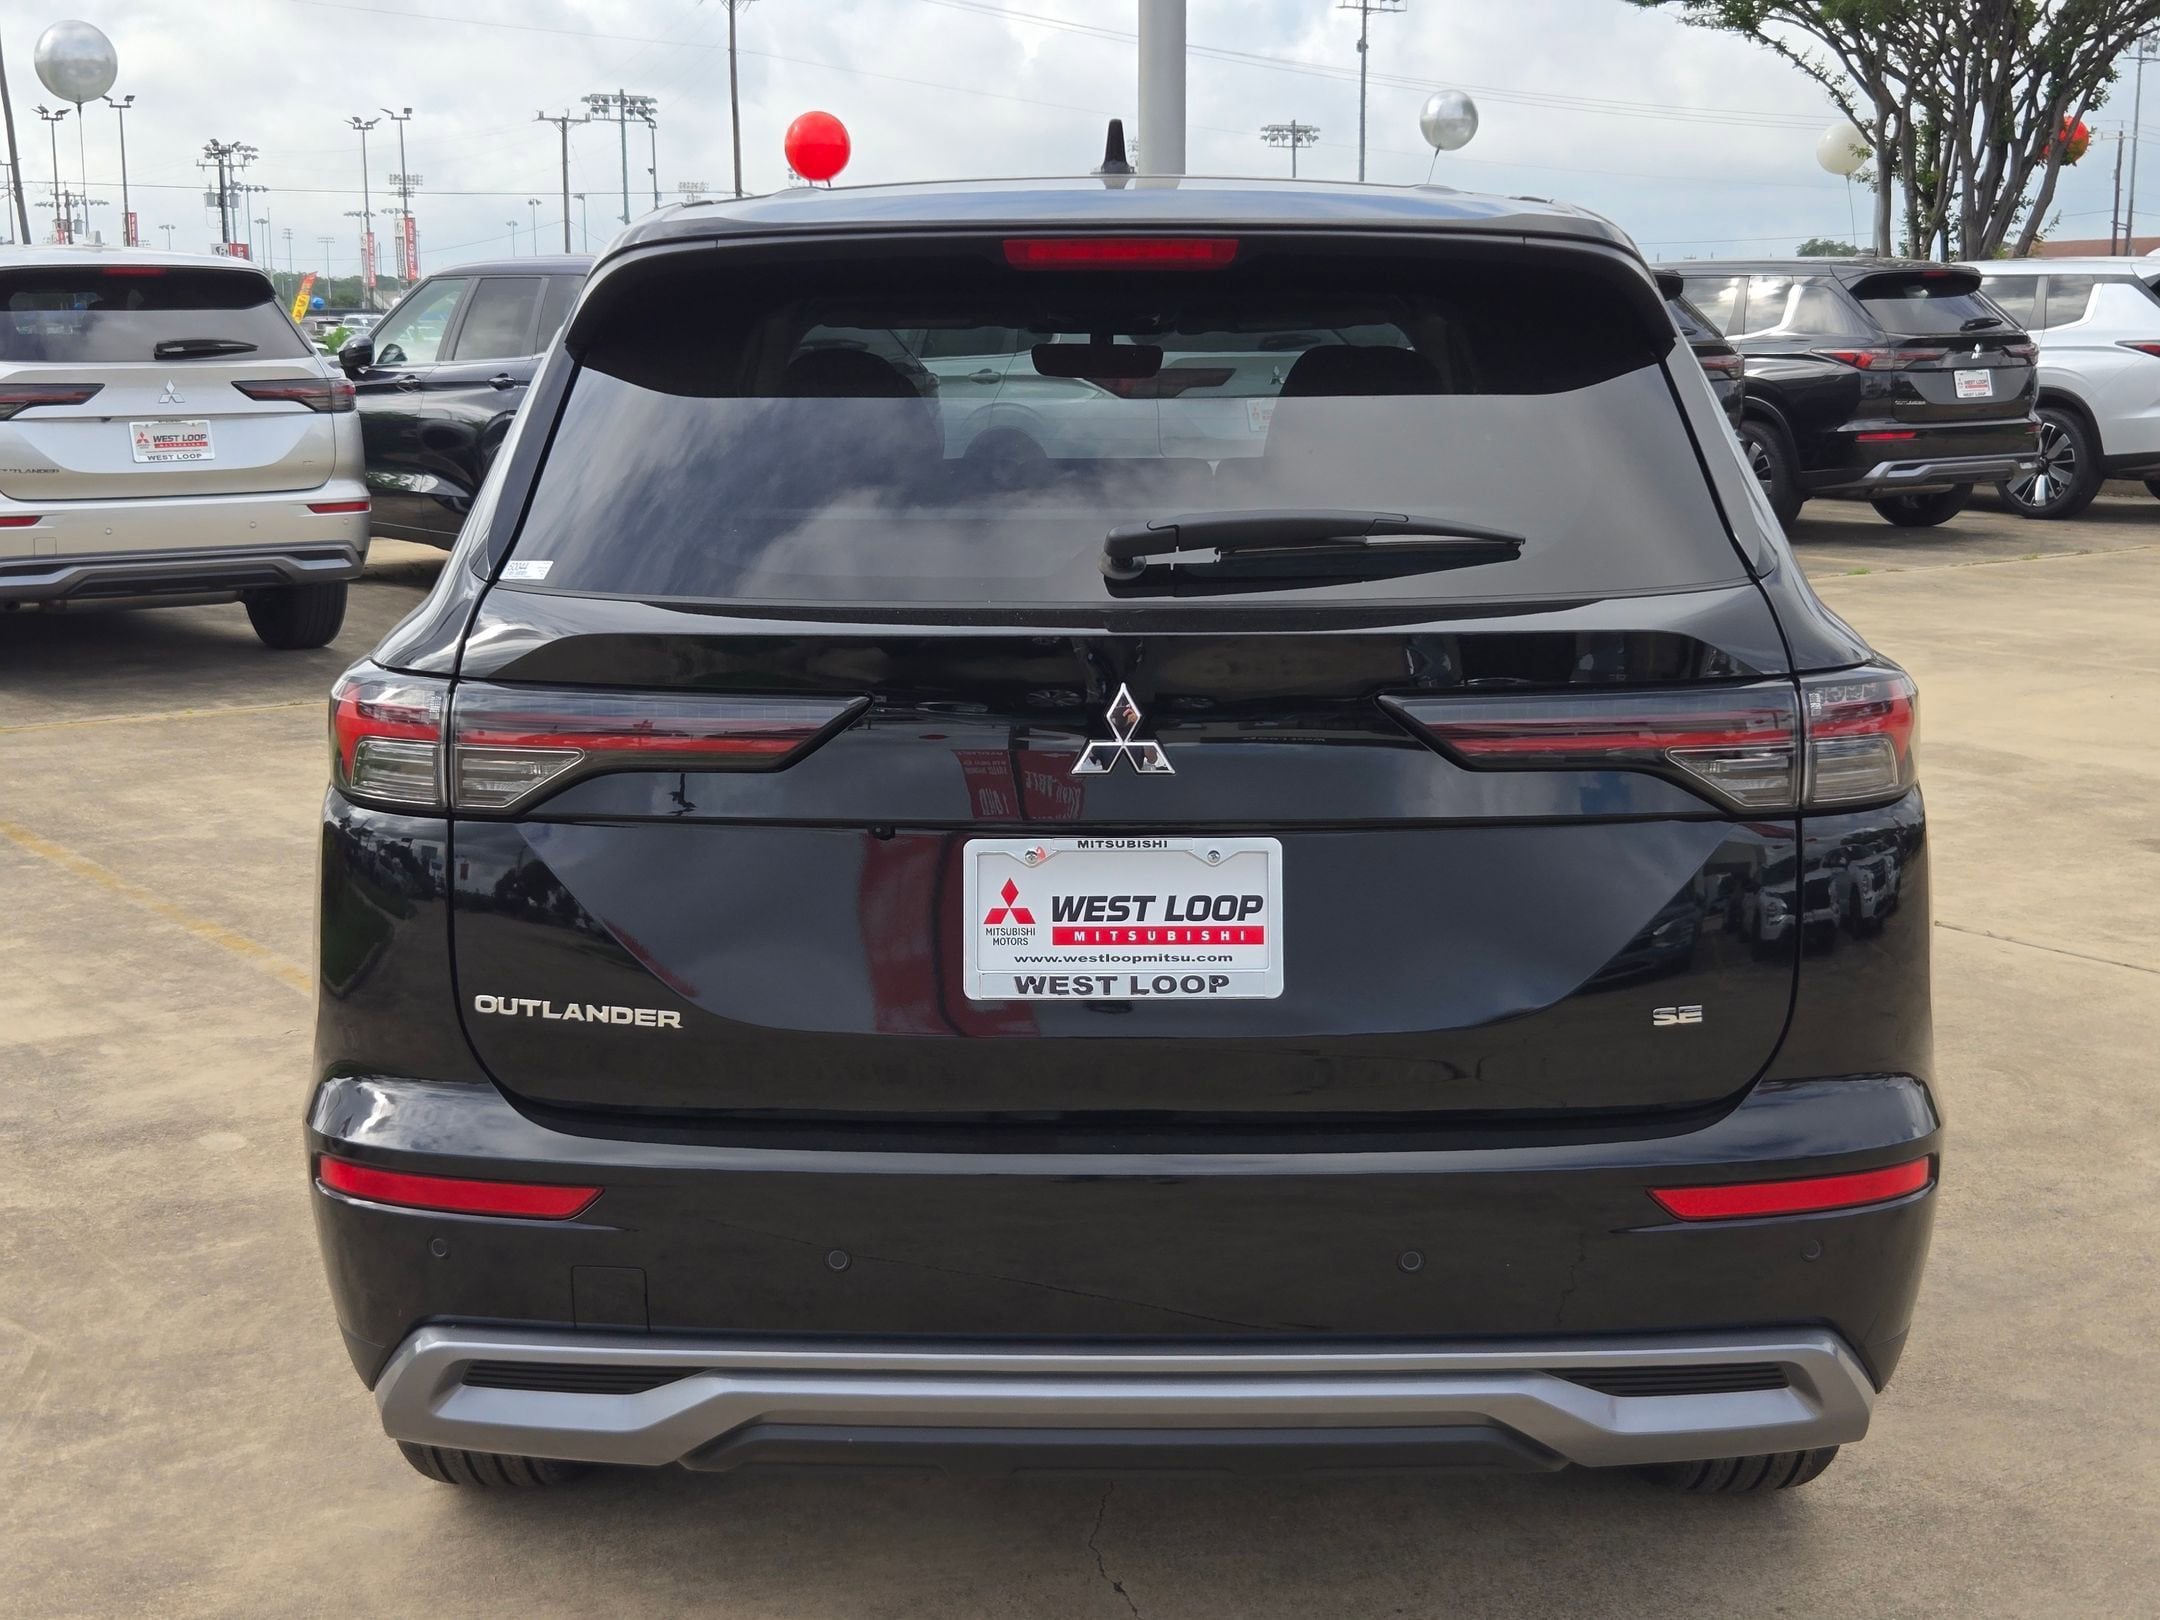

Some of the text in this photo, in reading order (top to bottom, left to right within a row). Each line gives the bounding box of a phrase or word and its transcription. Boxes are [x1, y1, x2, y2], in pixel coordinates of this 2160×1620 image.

[182, 433, 207, 441] LOOP
[1077, 840, 1168, 849] MITSUBISHI
[1052, 895, 1264, 922] WEST LOOP
[985, 927, 1036, 936] MITSUBISHI
[1074, 930, 1245, 942] MITSUBISHI
[992, 937, 1029, 946] MOTORS
[1014, 953, 1233, 964] www.westloopmitsu.com
[1014, 974, 1230, 996] WEST LOOP
[474, 994, 684, 1029] OUTLANDER
[1652, 1004, 1703, 1026] SE
